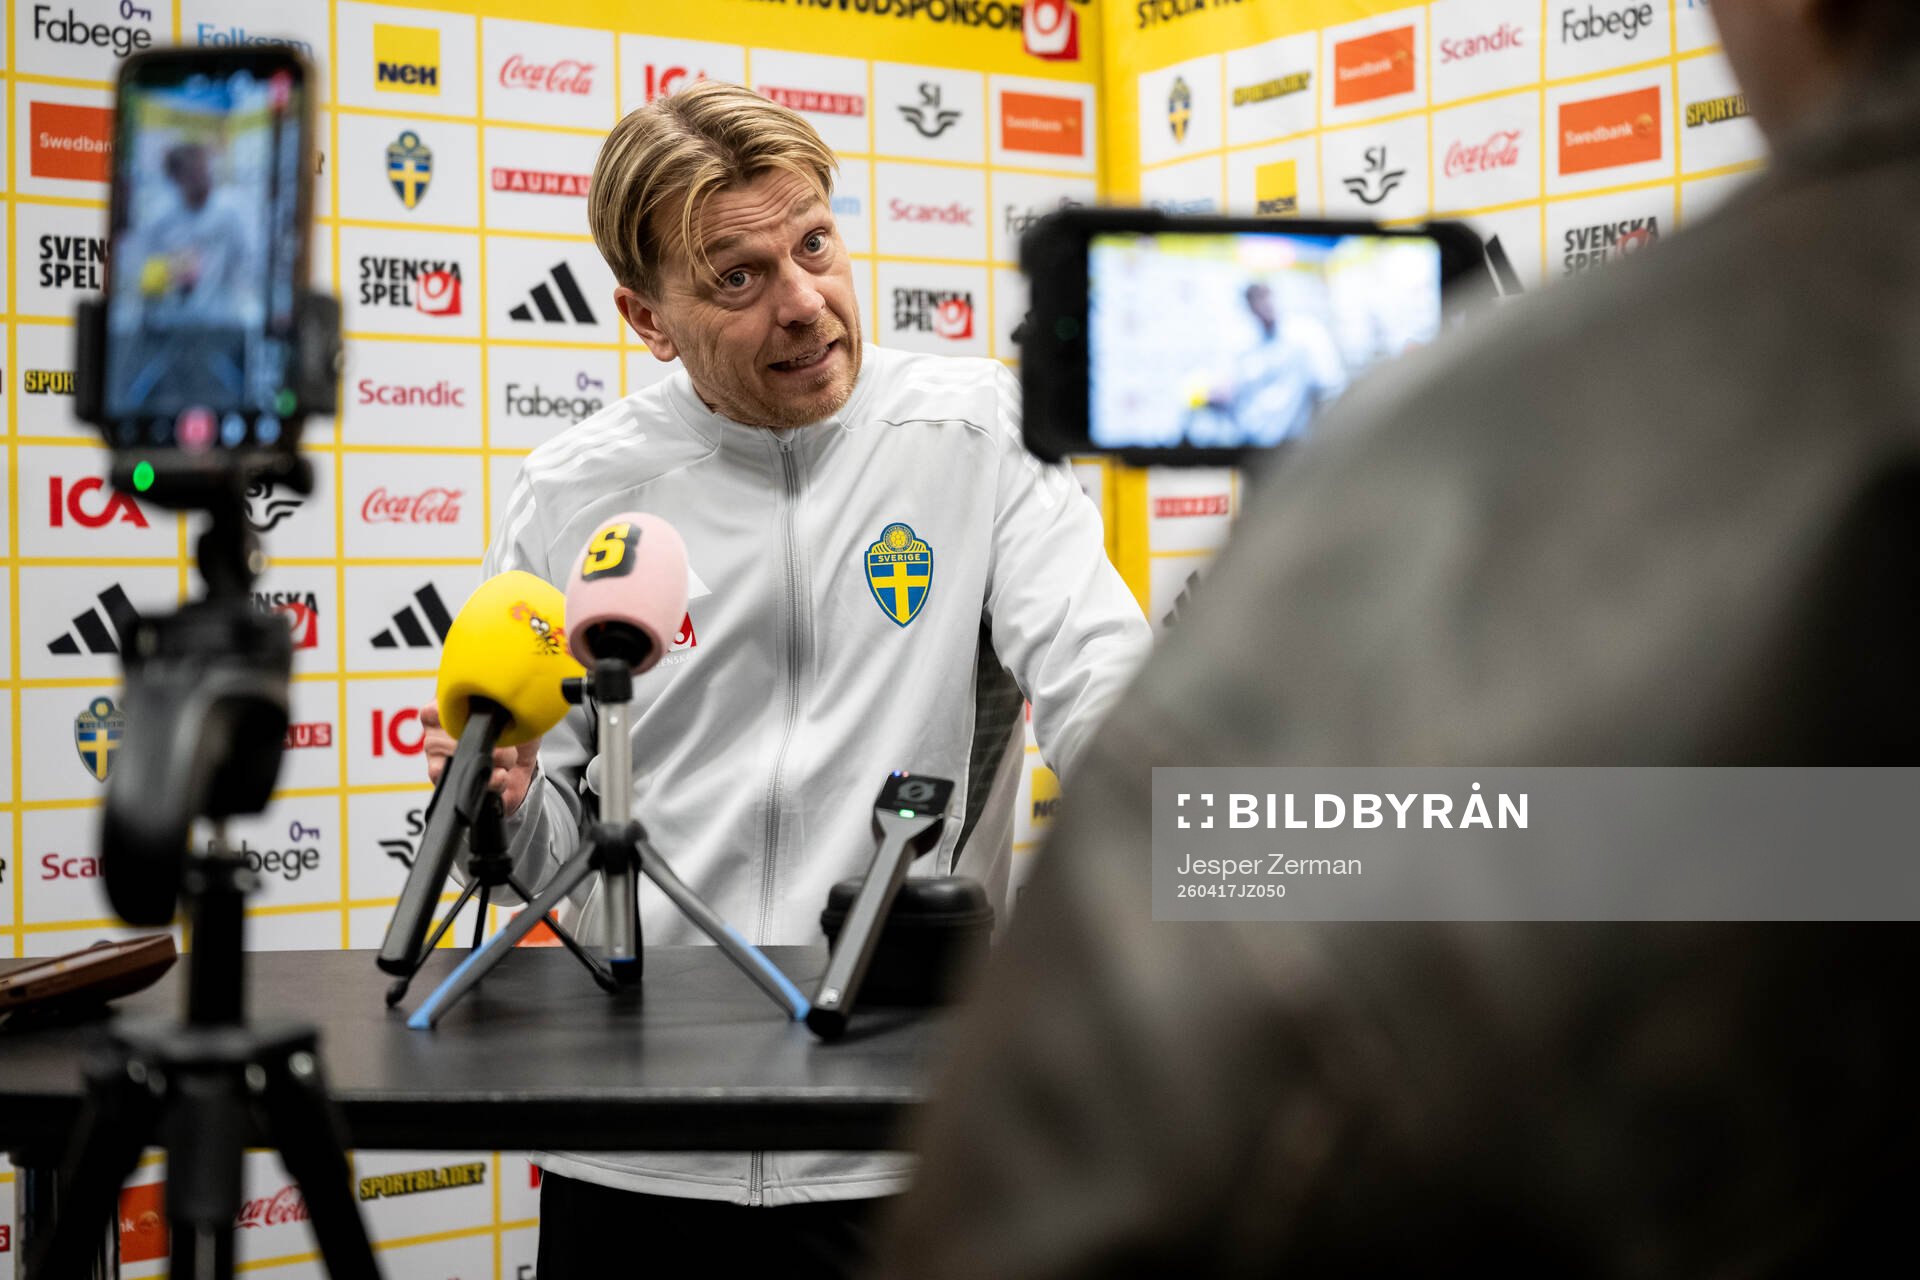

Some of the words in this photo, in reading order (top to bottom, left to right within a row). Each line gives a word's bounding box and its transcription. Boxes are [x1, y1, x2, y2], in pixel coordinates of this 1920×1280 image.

[33, 4, 152, 58] Fabege
[1562, 3, 1653, 44] Fabege
[1440, 24, 1523, 64] Scandic
[645, 64, 704, 104] IC
[1686, 95, 1751, 128] SPORTB
[40, 131, 112, 153] Swedban
[1565, 121, 1633, 147] Swedbank
[493, 168, 593, 197] BAUHAU
[39, 234, 106, 263] SVEN
[39, 262, 101, 290] SPEL
[359, 256, 462, 284] SVENSKA
[359, 282, 413, 307] SPEL
[358, 379, 464, 408] Scandic
[49, 475, 150, 528] ICA
[878, 553, 921, 563] SVERIGE
[254, 591, 319, 616] NSKA
[372, 708, 426, 758] IC
[241, 839, 320, 881] bege
[359, 1162, 486, 1200] SPORTBLADET
